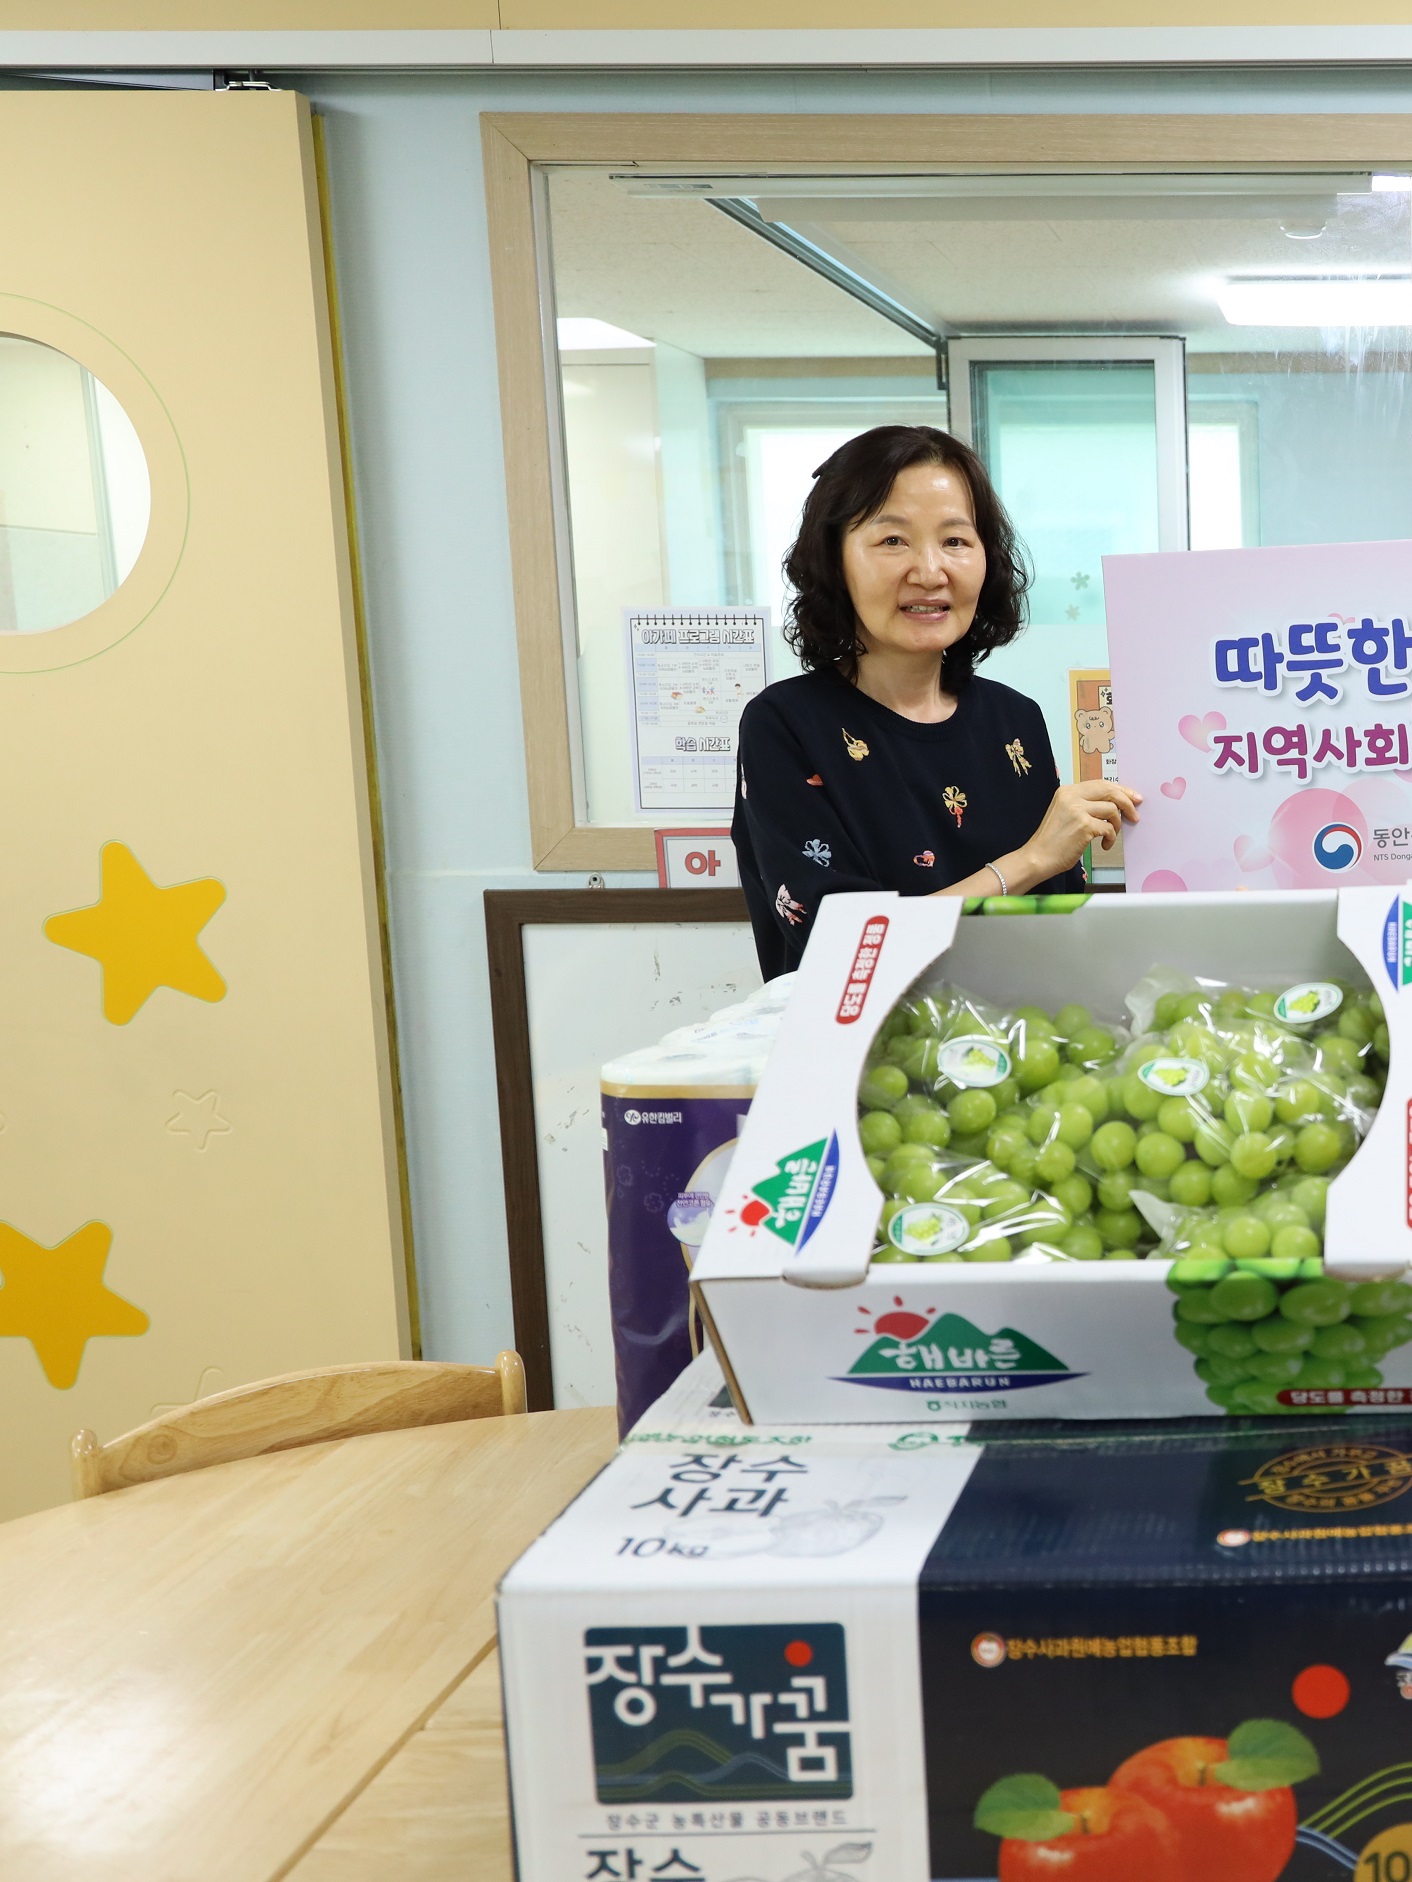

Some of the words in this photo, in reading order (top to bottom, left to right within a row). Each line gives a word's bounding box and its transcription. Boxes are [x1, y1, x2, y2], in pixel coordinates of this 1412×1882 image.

[641, 629, 677, 644] 아가페
[678, 629, 721, 644] 프로그램
[722, 629, 755, 644] 시간표
[675, 737, 698, 752] 학습
[699, 737, 731, 752] 시간표
[1373, 853, 1389, 861] NTS
[641, 1111, 683, 1125] 유한킴벌리
[878, 1337, 1022, 1371] 해바른
[909, 1376, 1011, 1389] HAEBARUN
[668, 1452, 809, 1485] 장수
[630, 1487, 792, 1519] 사과
[616, 1536, 710, 1560] 10kg
[583, 1624, 852, 1782] 장수가꿈
[605, 1811, 661, 1832] 장수군
[672, 1810, 744, 1831] 농특산물
[756, 1809, 848, 1829] 공동브랜드
